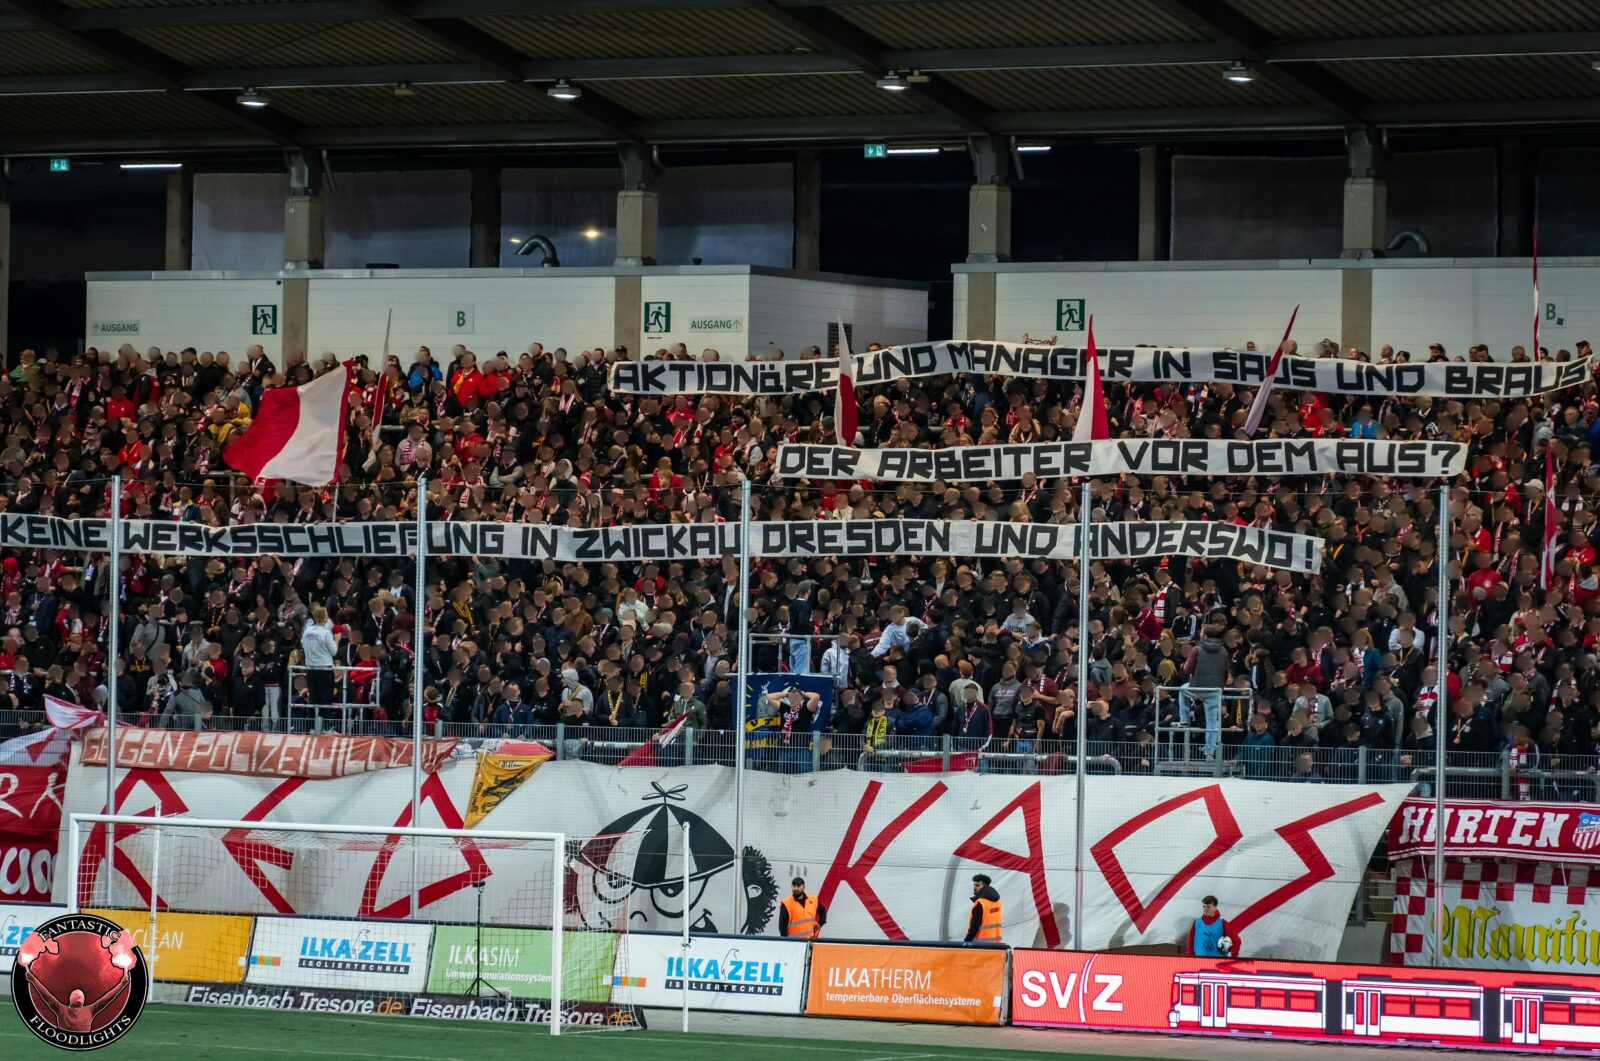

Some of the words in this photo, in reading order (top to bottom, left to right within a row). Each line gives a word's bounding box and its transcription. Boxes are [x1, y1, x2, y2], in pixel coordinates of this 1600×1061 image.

[456, 311, 467, 327] B
[1546, 303, 1556, 320] B
[100, 322, 139, 333] AUSGANG
[690, 320, 732, 329] AUSGANG
[856, 345, 937, 382] UND
[946, 342, 1134, 378] MANAGER
[1153, 350, 1191, 379] IN
[1212, 352, 1317, 388] SAUS
[1336, 363, 1425, 392] UND
[1445, 356, 1587, 396] BRAUS
[779, 446, 861, 476] DER
[877, 442, 1092, 480] ARBEITER
[1117, 440, 1208, 472] VOR
[1227, 440, 1317, 473] DEM
[1336, 441, 1461, 474] AUS?
[2, 514, 107, 548] KEINE
[521, 526, 558, 557] IN
[575, 525, 740, 558] ZWICKAU
[762, 521, 950, 553] DRESDEN
[975, 522, 1058, 555] UND
[1399, 806, 1569, 848] HARTEN
[817, 779, 1386, 949] KAOS
[300, 937, 353, 959] ILKA
[357, 941, 411, 962] ZELL
[448, 945, 519, 967] ILKASIM
[301, 960, 406, 974] ISOLIERTECHNIK
[666, 957, 720, 980] ILKA
[727, 961, 784, 983] ZELL
[828, 967, 932, 990] ILKATHERM
[668, 981, 779, 995] ISLIERTECHNIK
[826, 991, 889, 1004] temperierbare
[892, 992, 982, 1008] Oberflächensysteme
[188, 986, 294, 1010] Eisenbach
[300, 991, 375, 1014] Tresore
[410, 998, 518, 1022] Eisenbach
